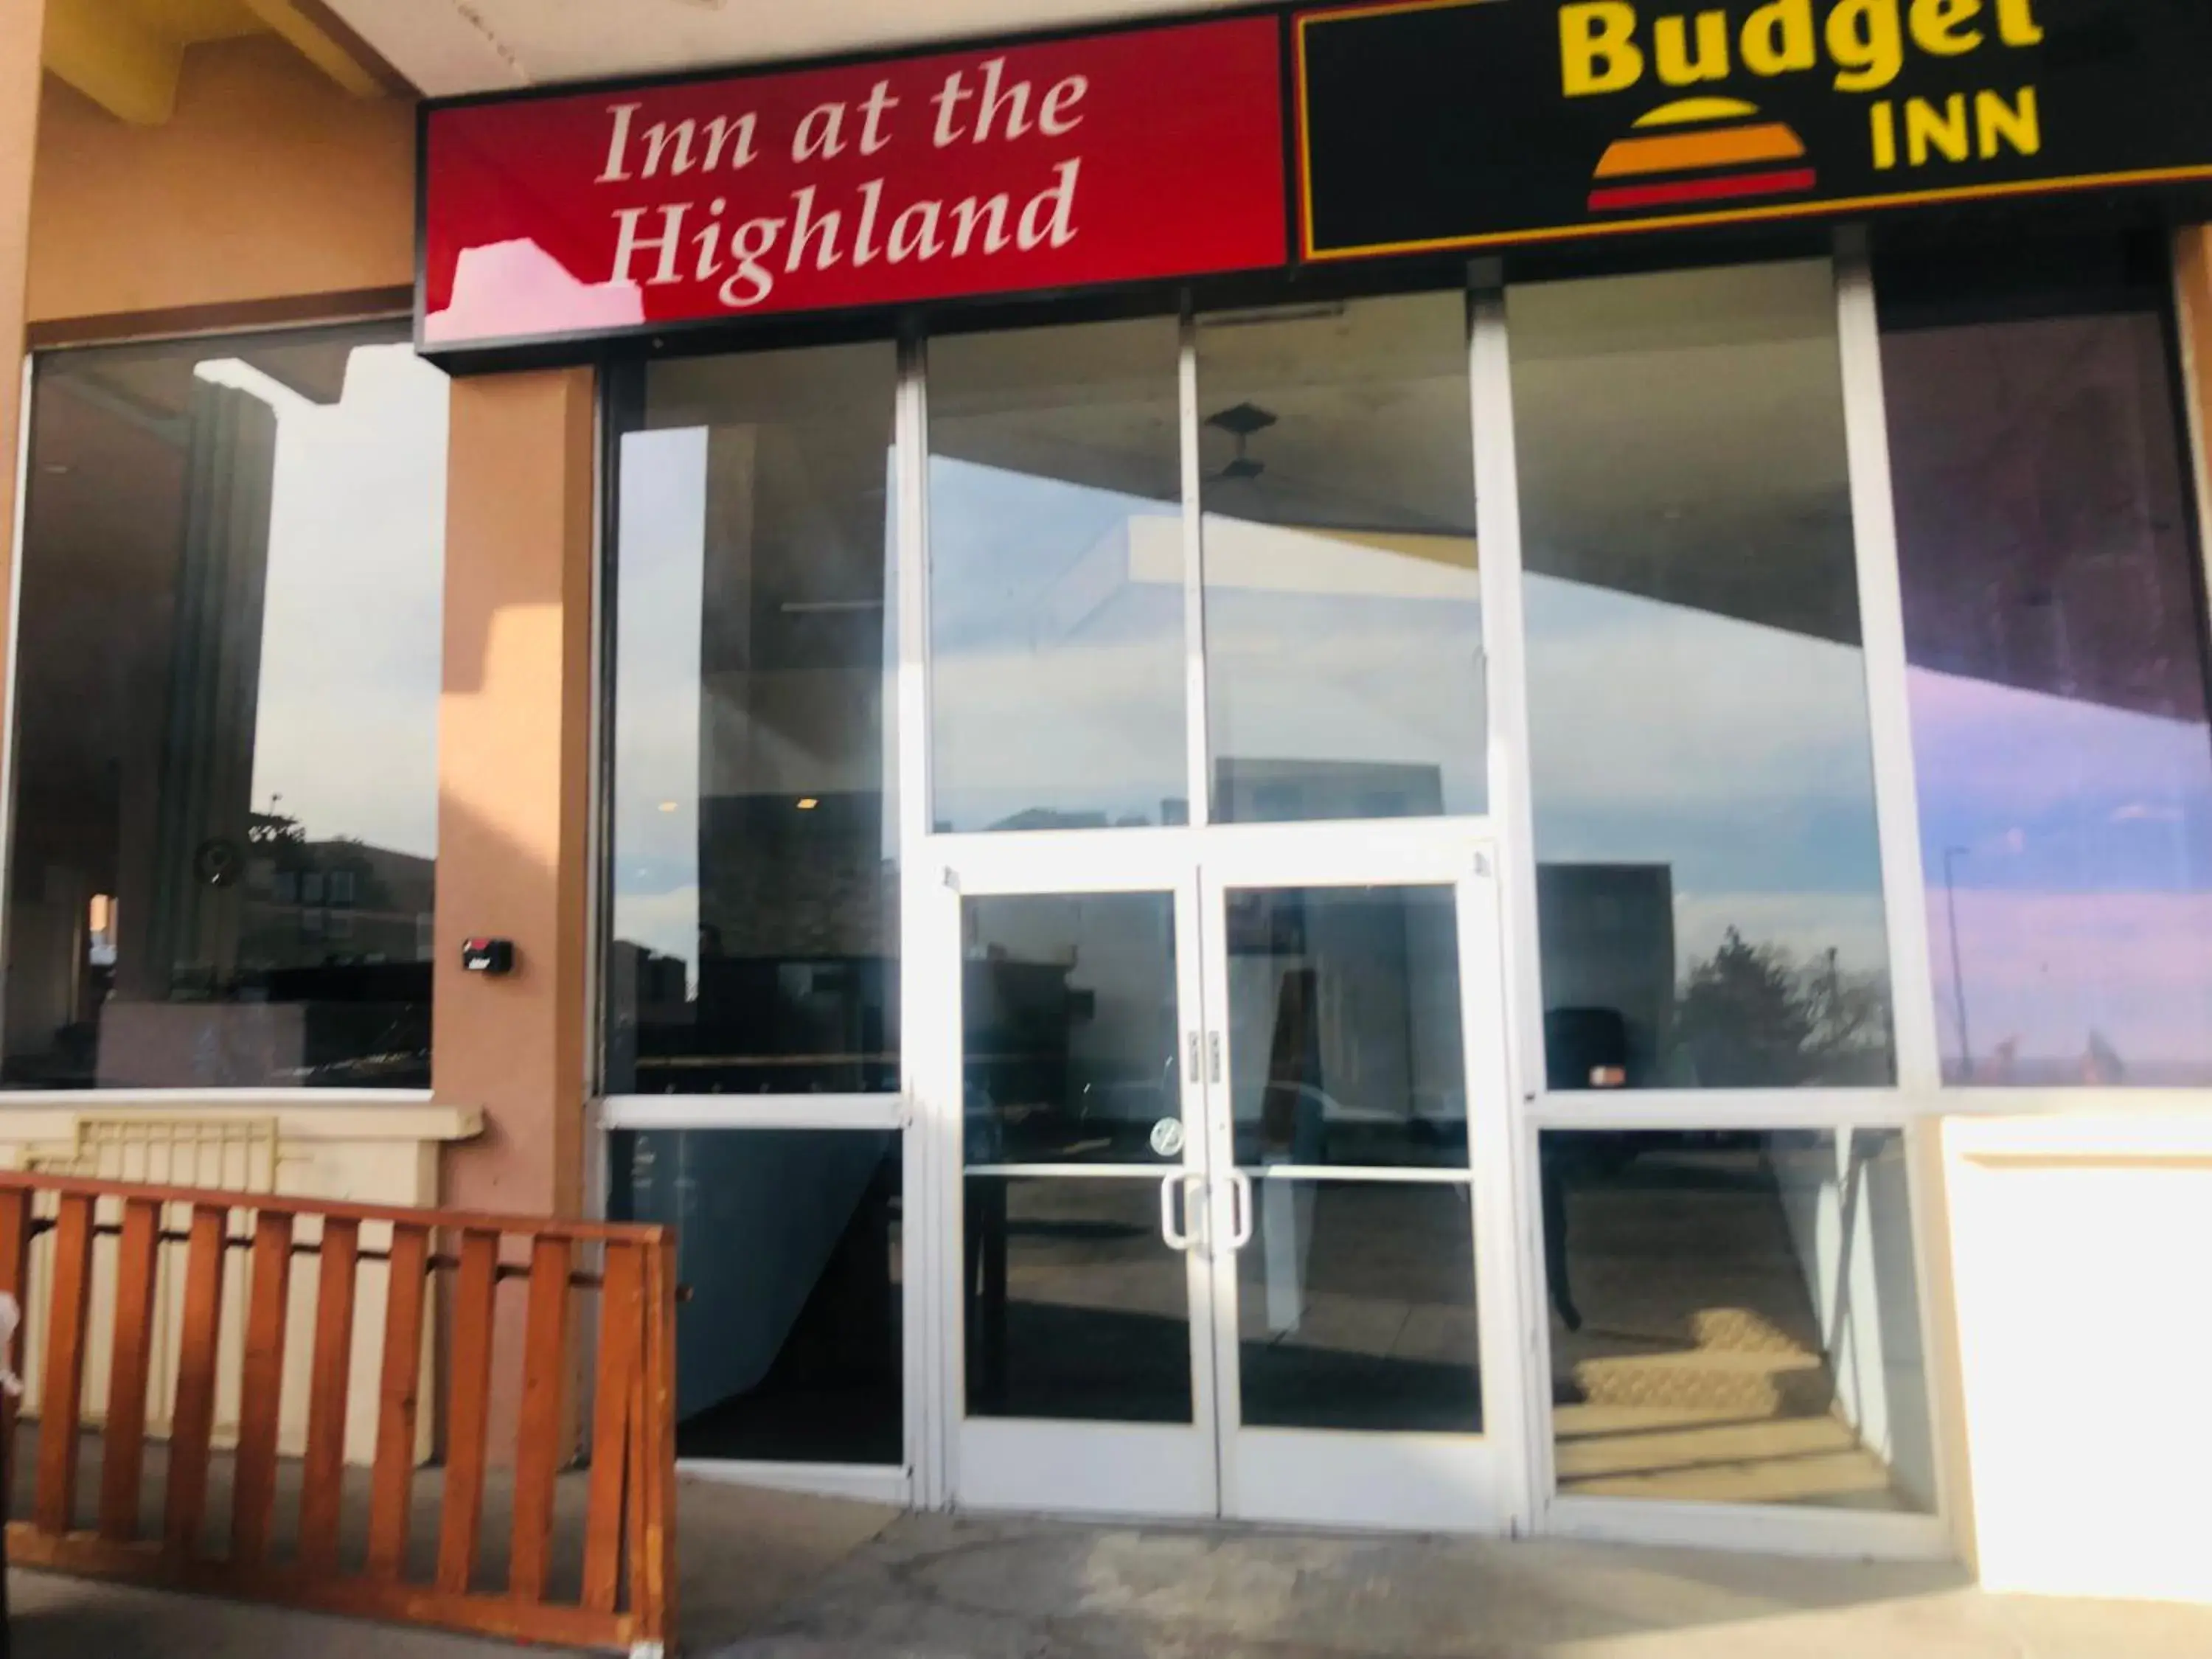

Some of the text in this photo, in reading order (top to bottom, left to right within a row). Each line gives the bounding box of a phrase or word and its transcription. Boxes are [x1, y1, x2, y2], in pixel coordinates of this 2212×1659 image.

[594, 56, 1090, 184] Inn at the
[1870, 86, 2040, 170] INN
[611, 156, 1082, 307] Highland
